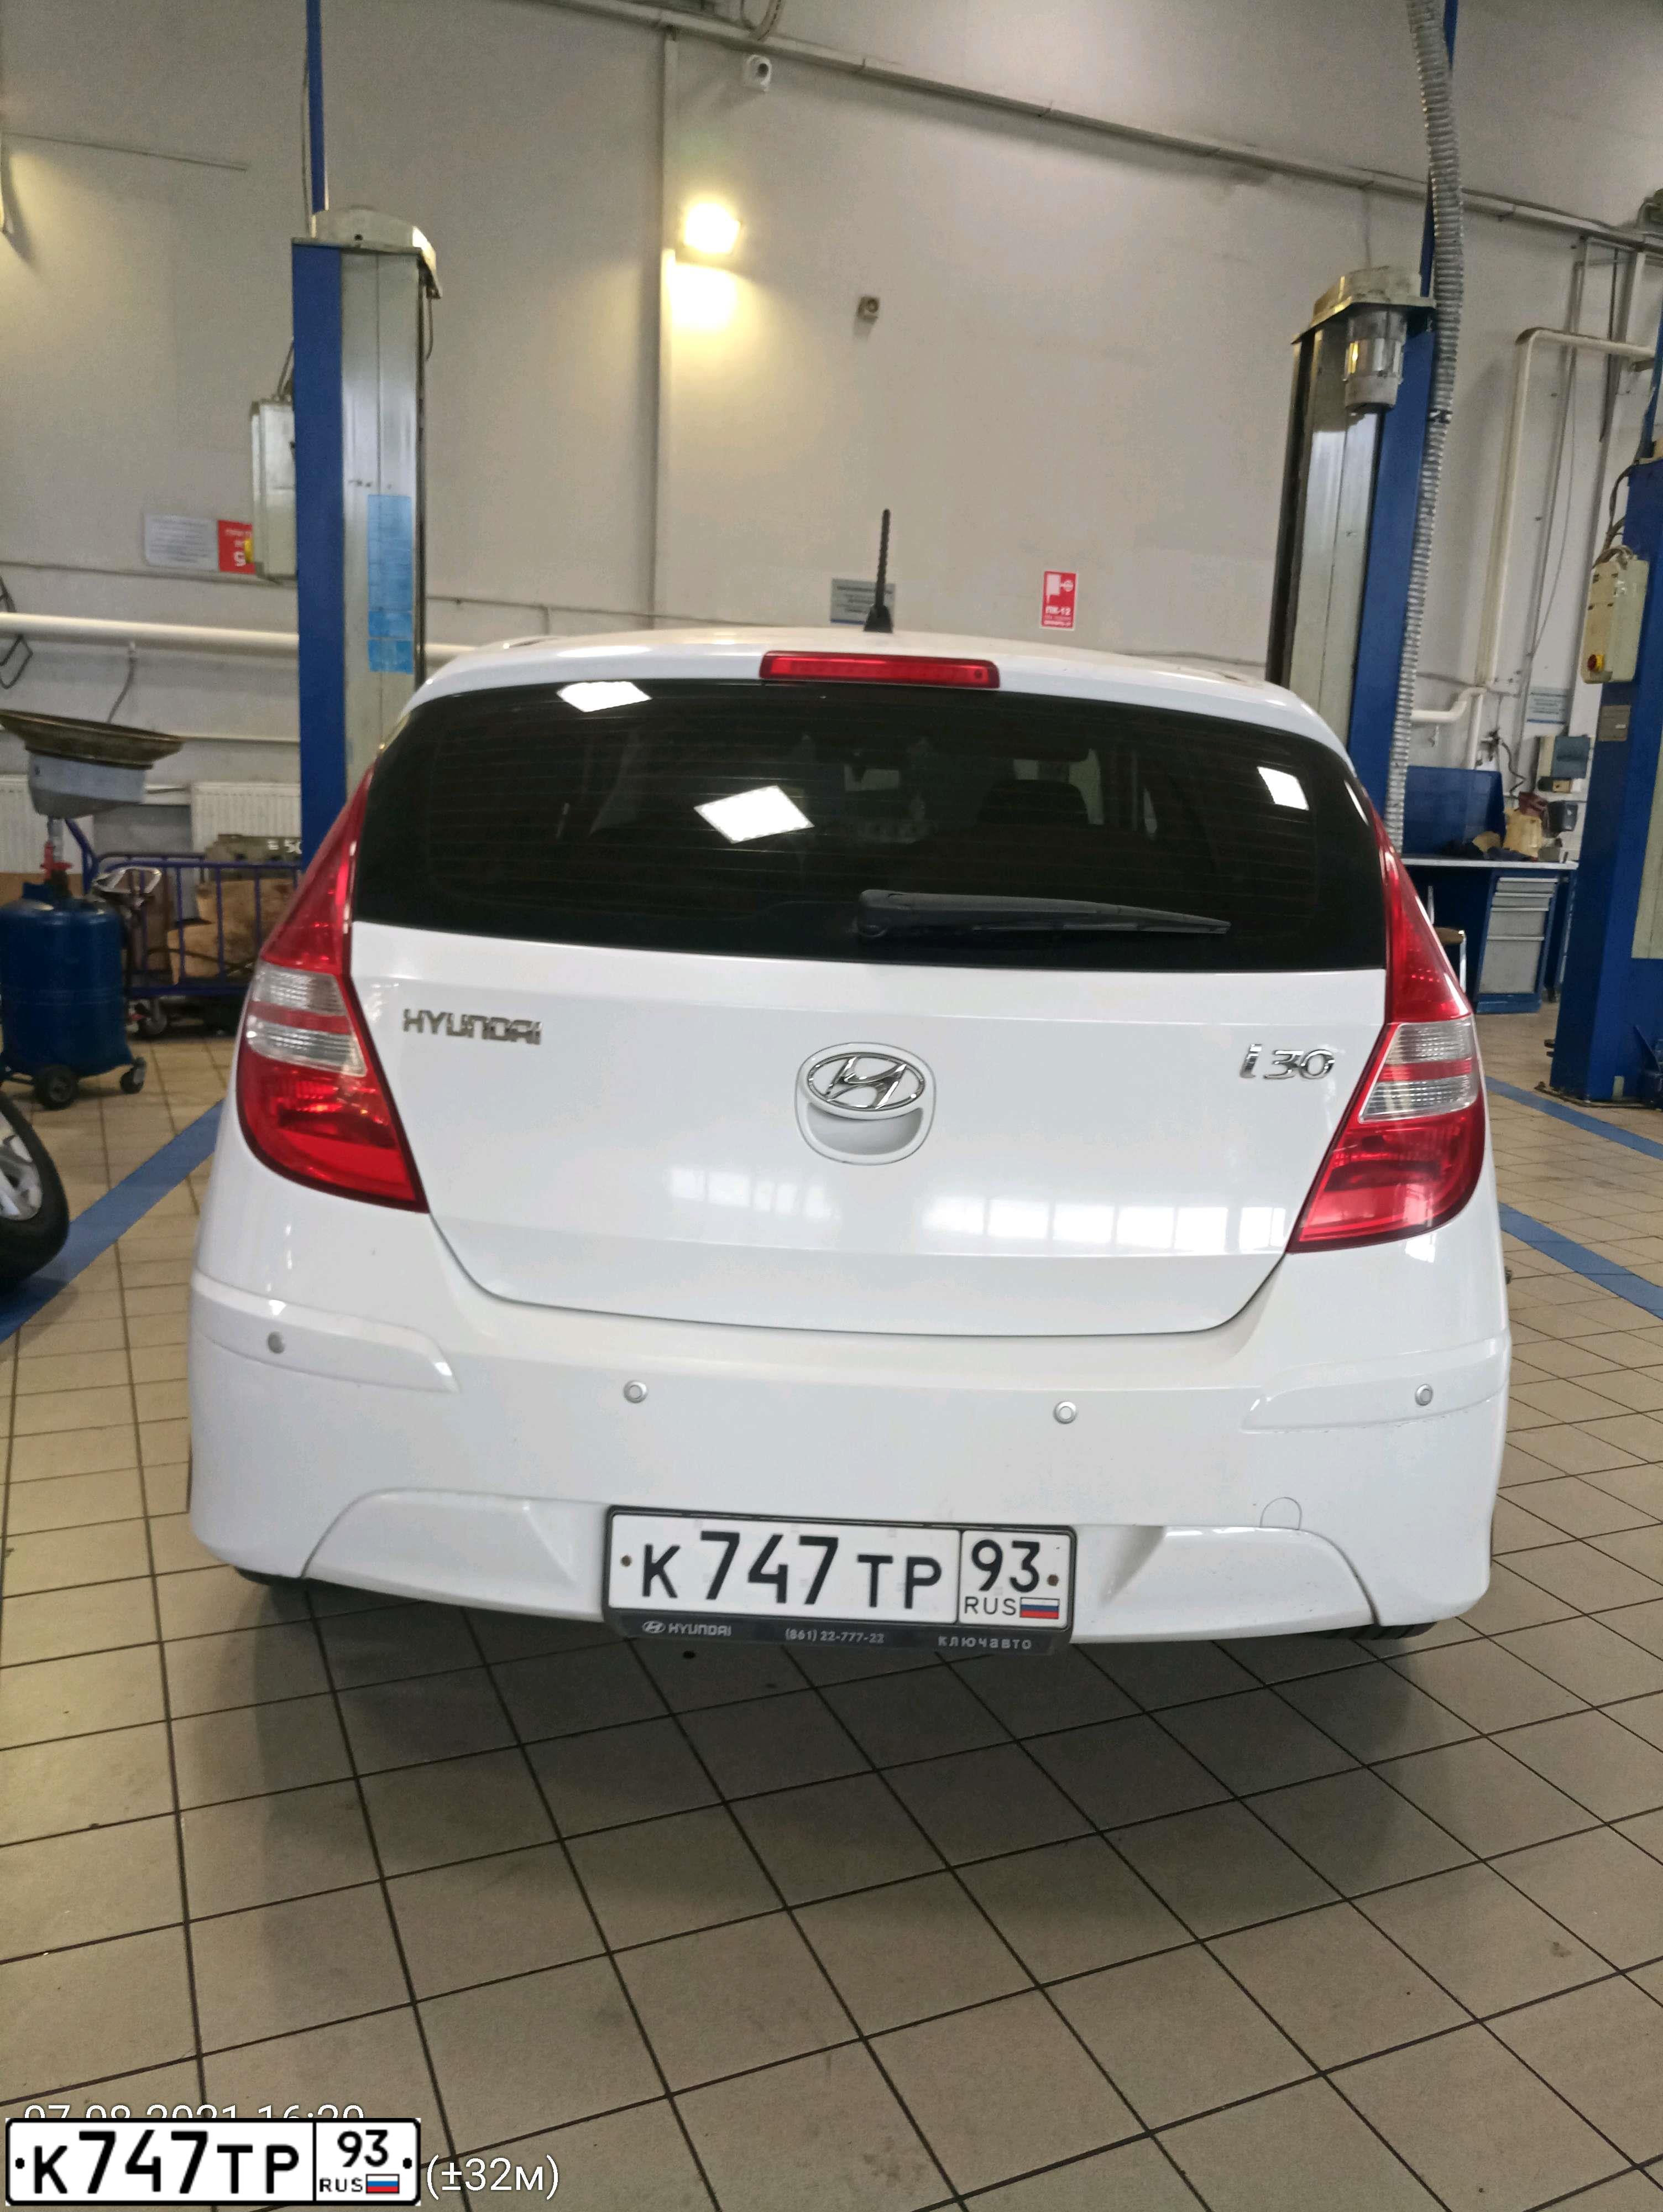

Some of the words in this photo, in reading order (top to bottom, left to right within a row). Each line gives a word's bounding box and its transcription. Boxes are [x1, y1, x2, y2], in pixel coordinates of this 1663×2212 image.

[402, 1008, 542, 1045] HYUNDAI
[971, 1538, 1040, 1593] 93
[964, 1596, 1017, 1616] RUS
[668, 1623, 732, 1636] HYUNDAI
[785, 1628, 817, 1642] (861)
[820, 1631, 885, 1644] 22-777-22
